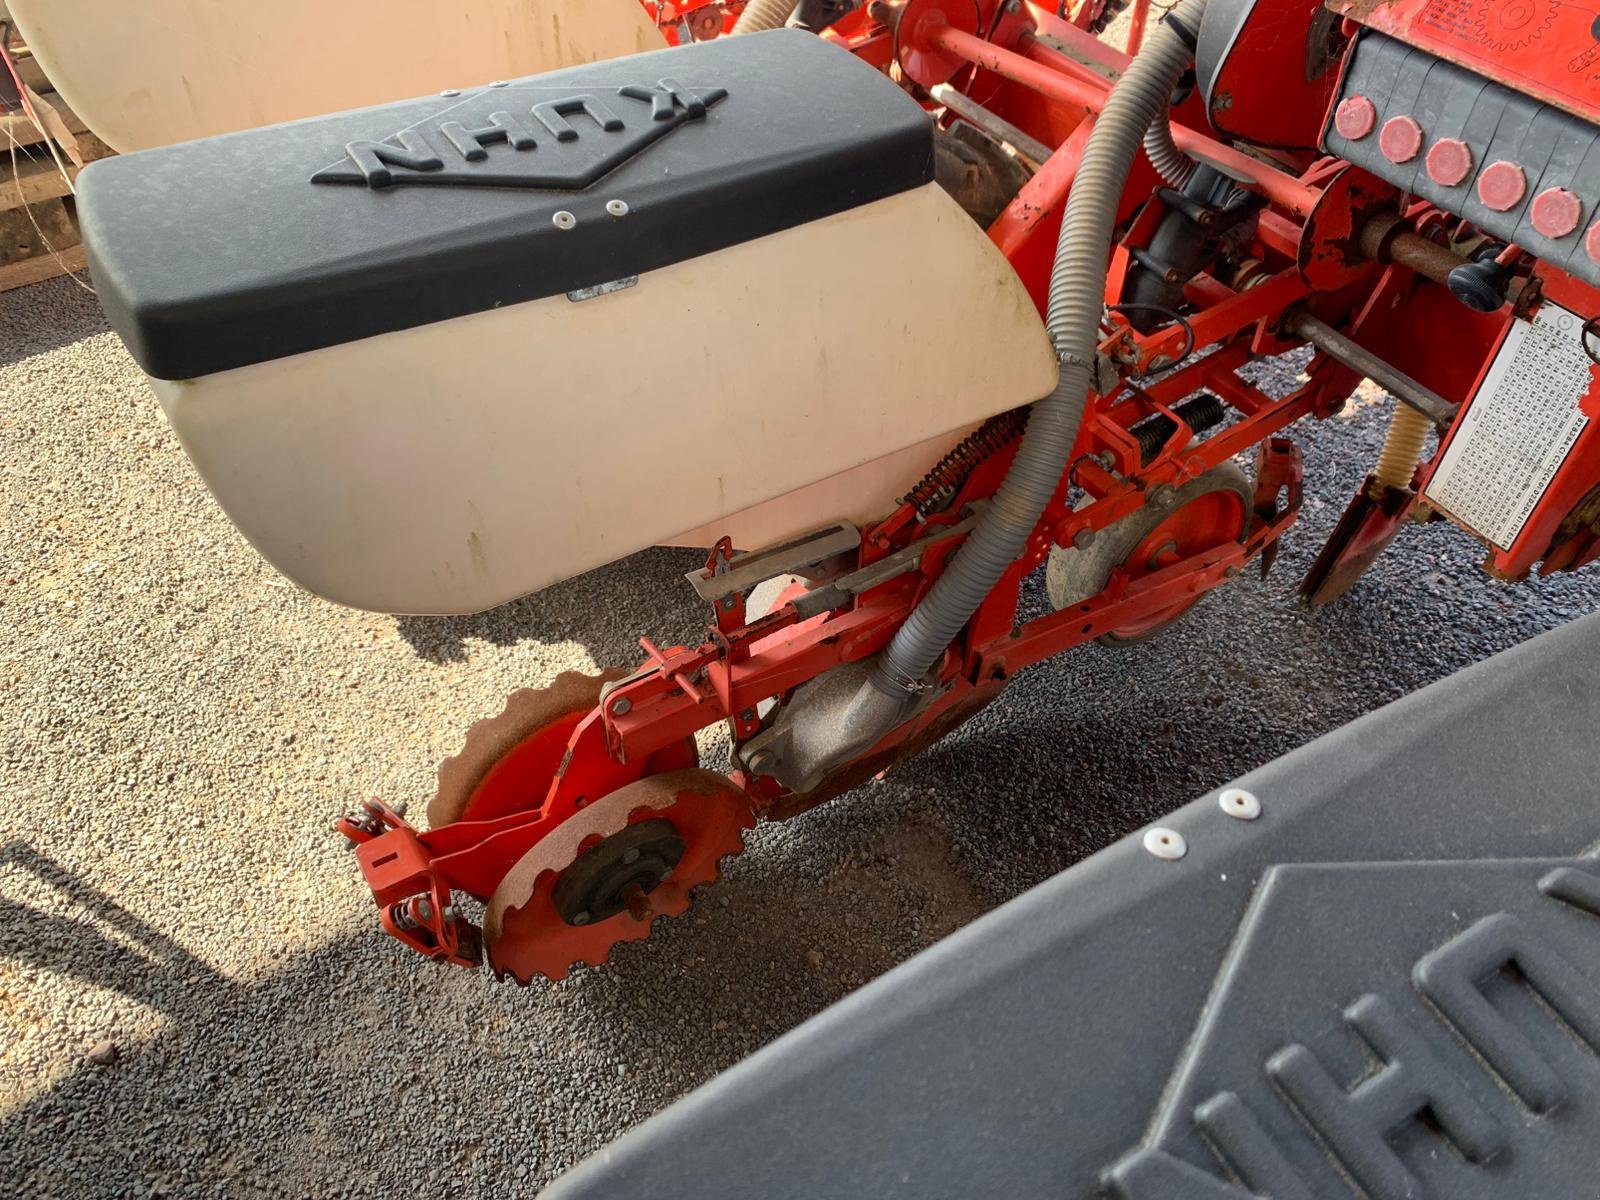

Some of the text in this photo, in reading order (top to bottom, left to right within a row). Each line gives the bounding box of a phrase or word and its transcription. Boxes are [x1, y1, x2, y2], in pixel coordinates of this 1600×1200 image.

[345, 78, 706, 189] KUHN
[1575, 417, 1584, 428] B2
[1569, 427, 1578, 437] B3
[1563, 436, 1572, 446] B4
[1558, 446, 1566, 455] C1
[1553, 455, 1561, 464] C2
[1547, 464, 1555, 473] C3
[1542, 472, 1550, 482] C4
[1537, 481, 1545, 490] D1
[1531, 490, 1540, 499] D2
[1526, 498, 1535, 508] D3
[1521, 506, 1530, 516] D4
[1511, 524, 1519, 532] E2
[1506, 532, 1514, 540] E3
